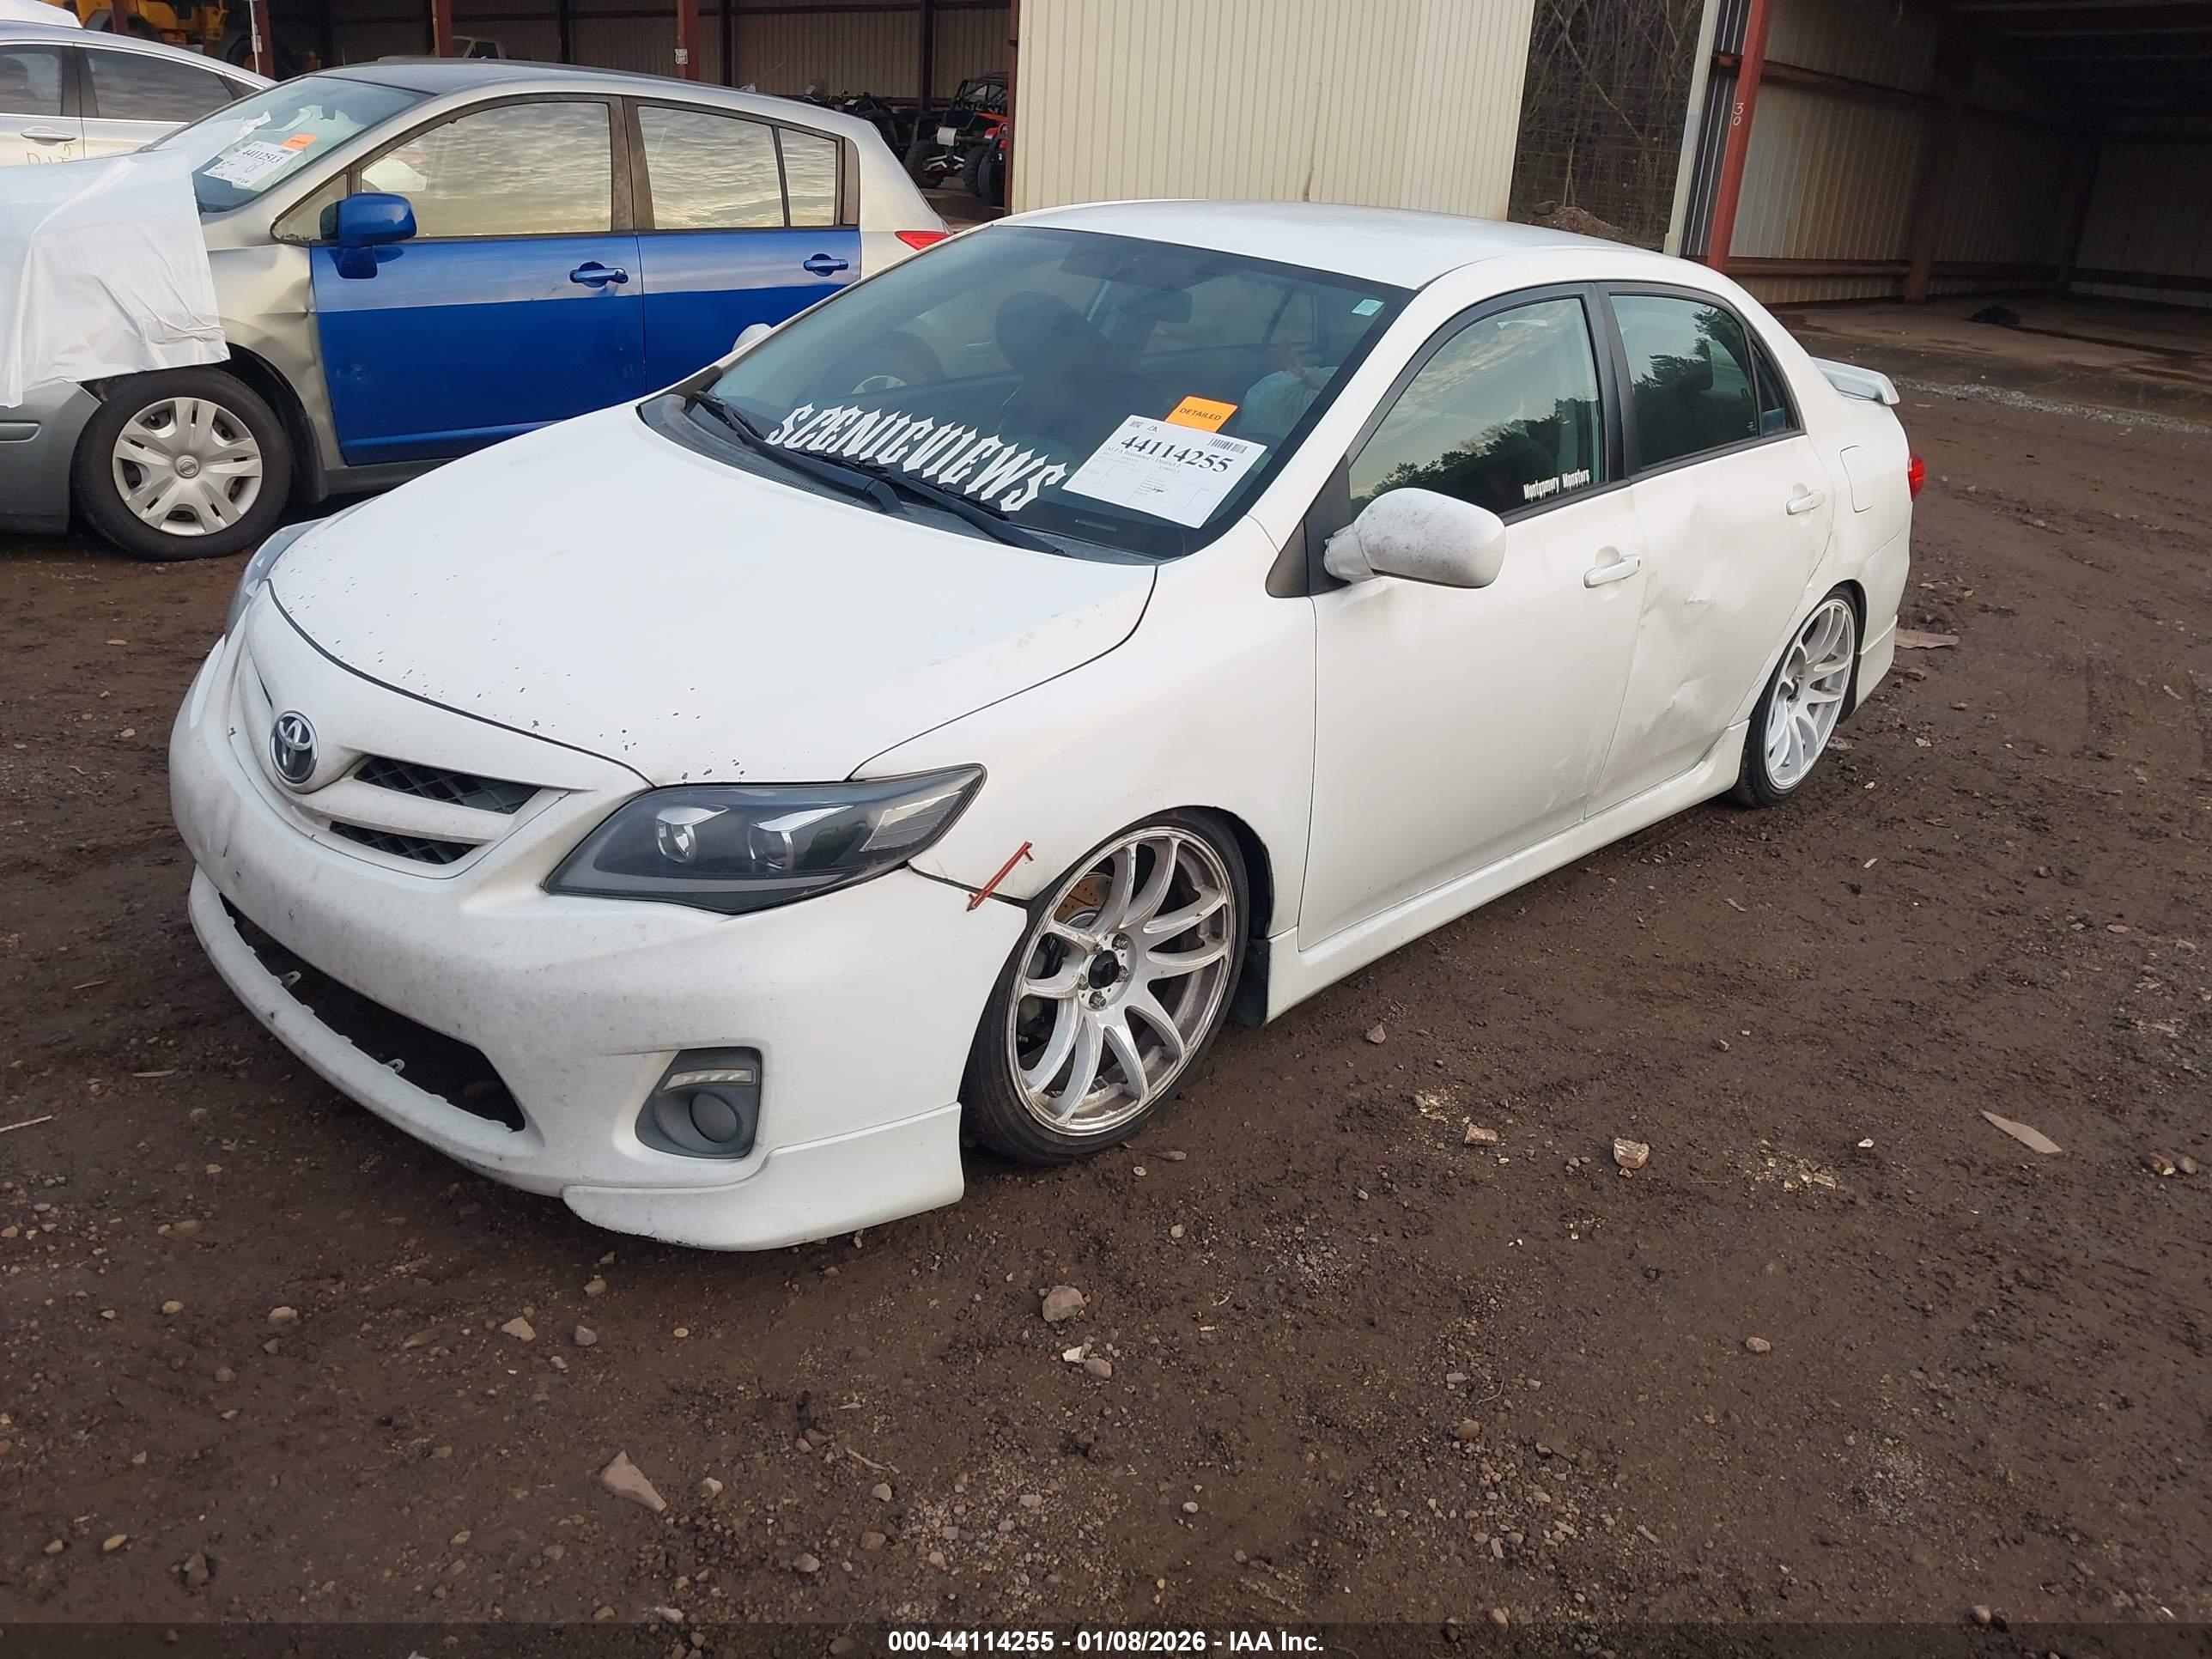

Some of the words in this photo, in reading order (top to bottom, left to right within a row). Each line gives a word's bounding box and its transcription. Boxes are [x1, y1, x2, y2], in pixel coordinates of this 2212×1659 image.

[1734, 102, 1744, 125] 30
[1179, 408, 1222, 422] DETAILED
[764, 402, 1067, 512] SCENICVIEWS
[1120, 434, 1234, 473] 44114255
